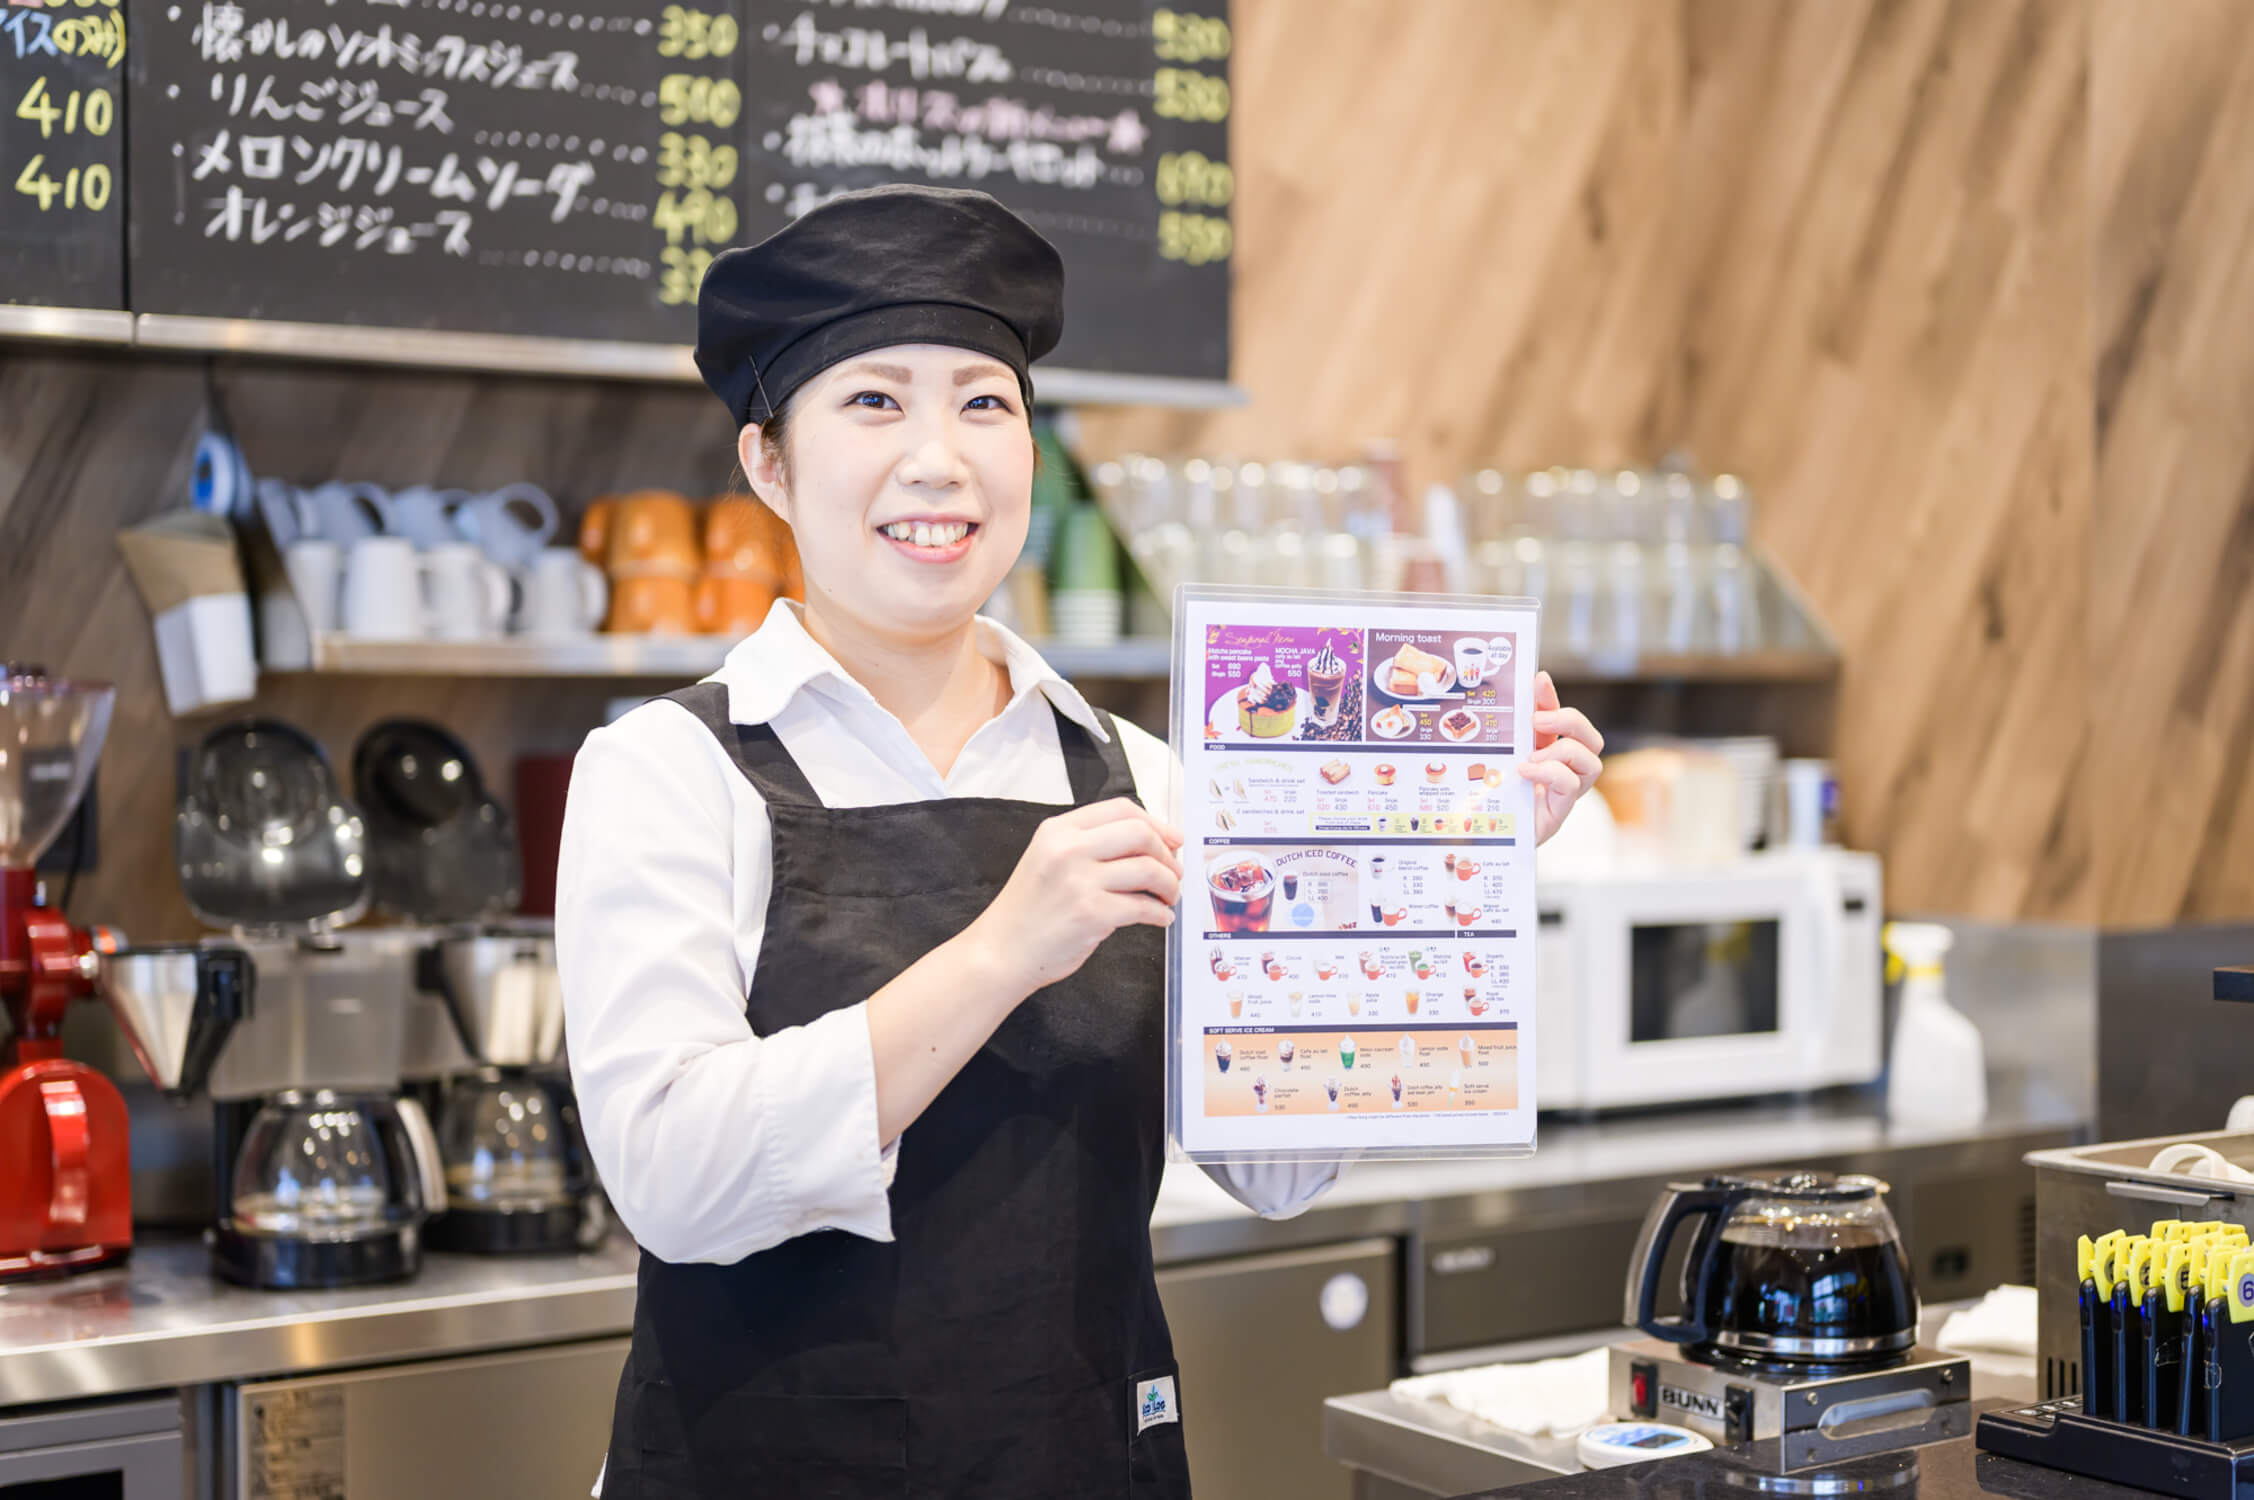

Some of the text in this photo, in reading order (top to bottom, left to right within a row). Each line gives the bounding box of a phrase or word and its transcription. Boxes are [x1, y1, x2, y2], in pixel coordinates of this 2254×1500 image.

[15, 76, 112, 138] 410
[14, 154, 112, 211] 410
[1375, 633, 1442, 643] Morning toast
[1276, 849, 1358, 868] DUTCH ICED COFFEE
[1662, 1388, 1719, 1415] BUNN
